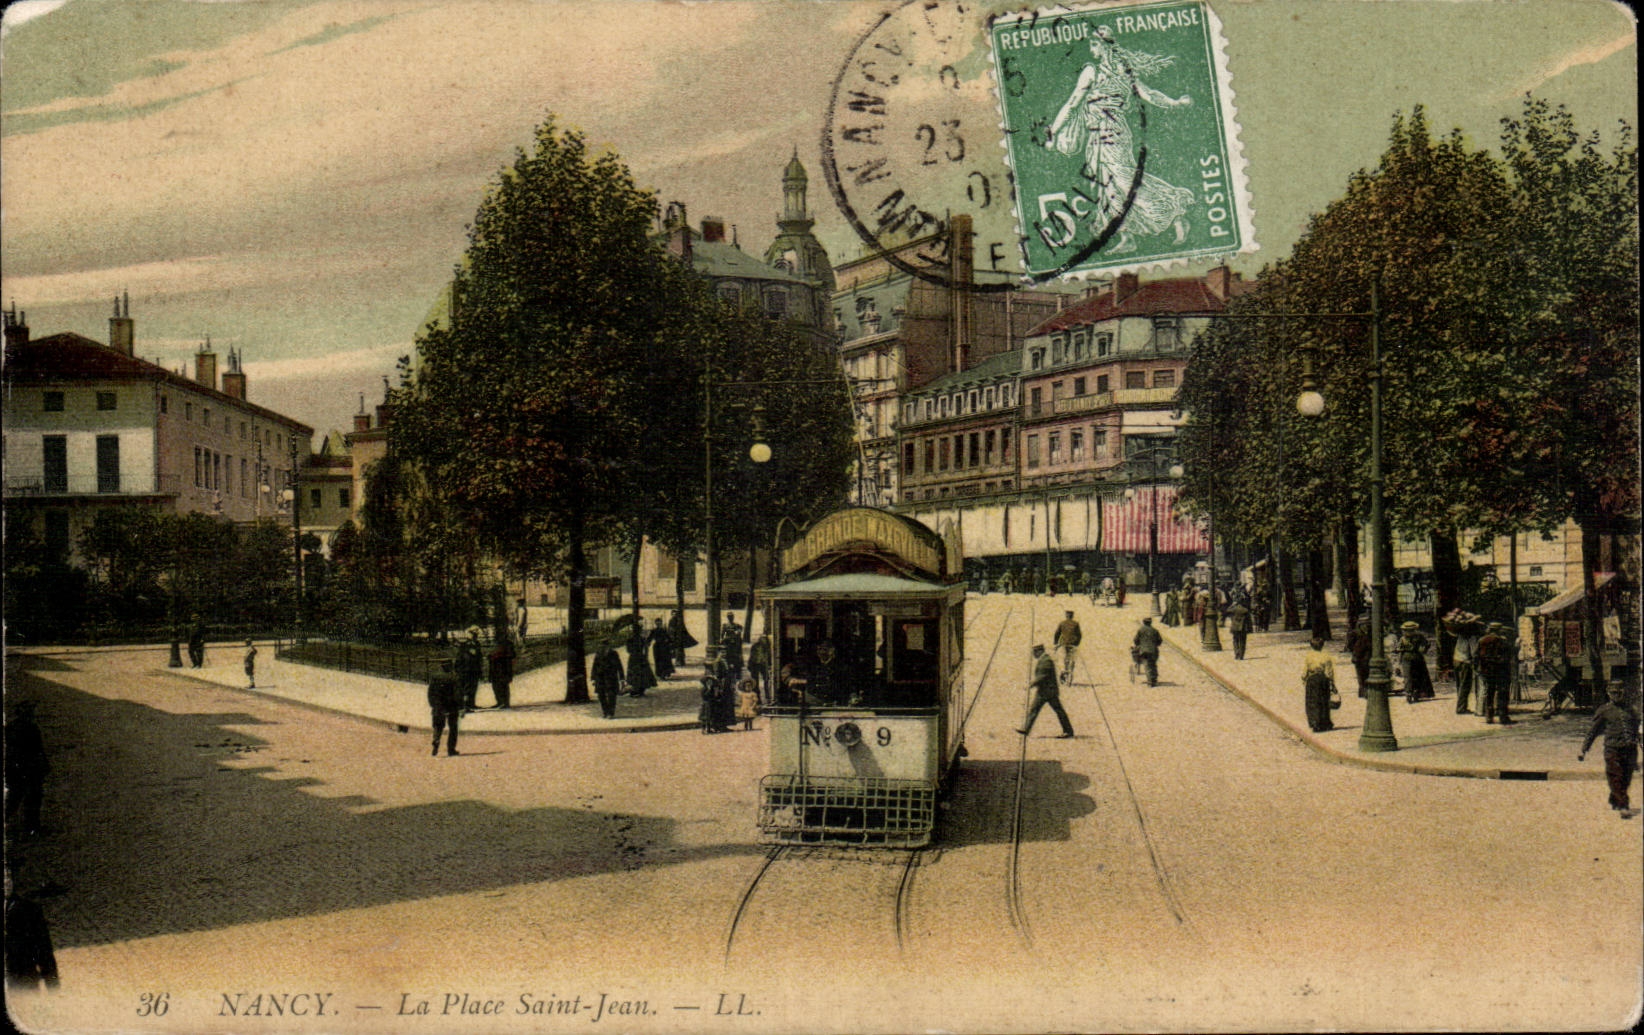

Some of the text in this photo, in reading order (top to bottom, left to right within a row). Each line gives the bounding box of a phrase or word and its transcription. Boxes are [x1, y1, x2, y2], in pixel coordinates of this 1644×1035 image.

[1116, 8, 1200, 34] FRANÇAISE
[1200, 154, 1230, 238] POSTES
[876, 726, 892, 747] 9
